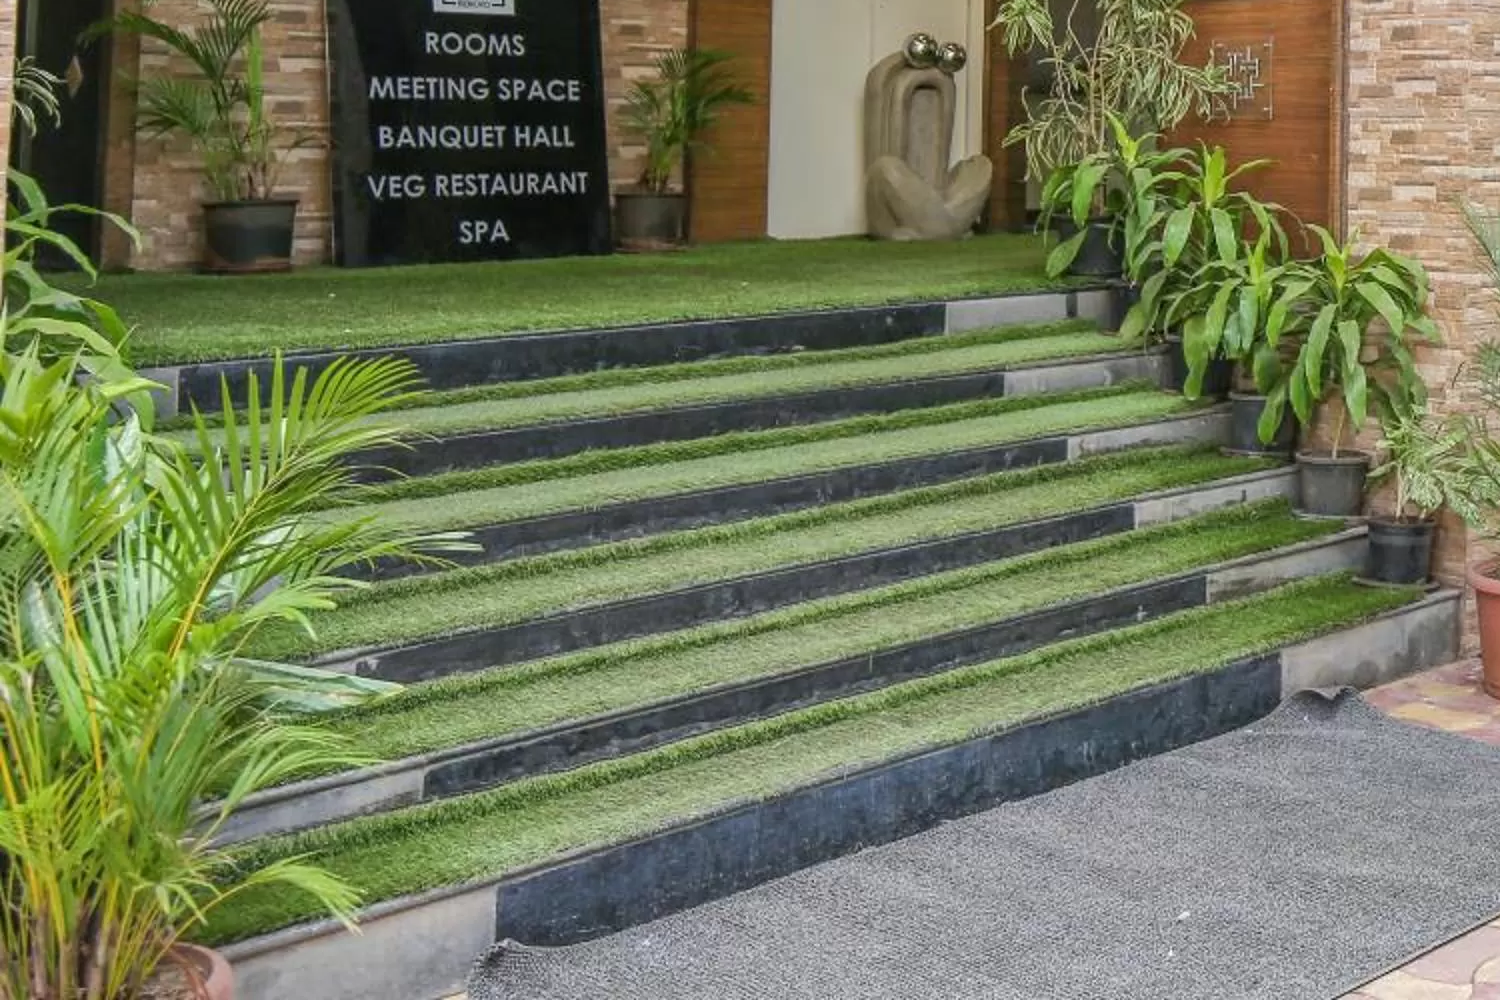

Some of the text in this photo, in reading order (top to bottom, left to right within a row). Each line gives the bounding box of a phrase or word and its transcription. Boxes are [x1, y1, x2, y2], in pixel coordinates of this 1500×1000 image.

[425, 32, 526, 57] ROOMS
[369, 76, 580, 102] MEETING SPACE
[378, 125, 575, 150] BANQUET HALL
[368, 172, 588, 199] VEG RESTAURANT
[459, 219, 510, 244] SPA
